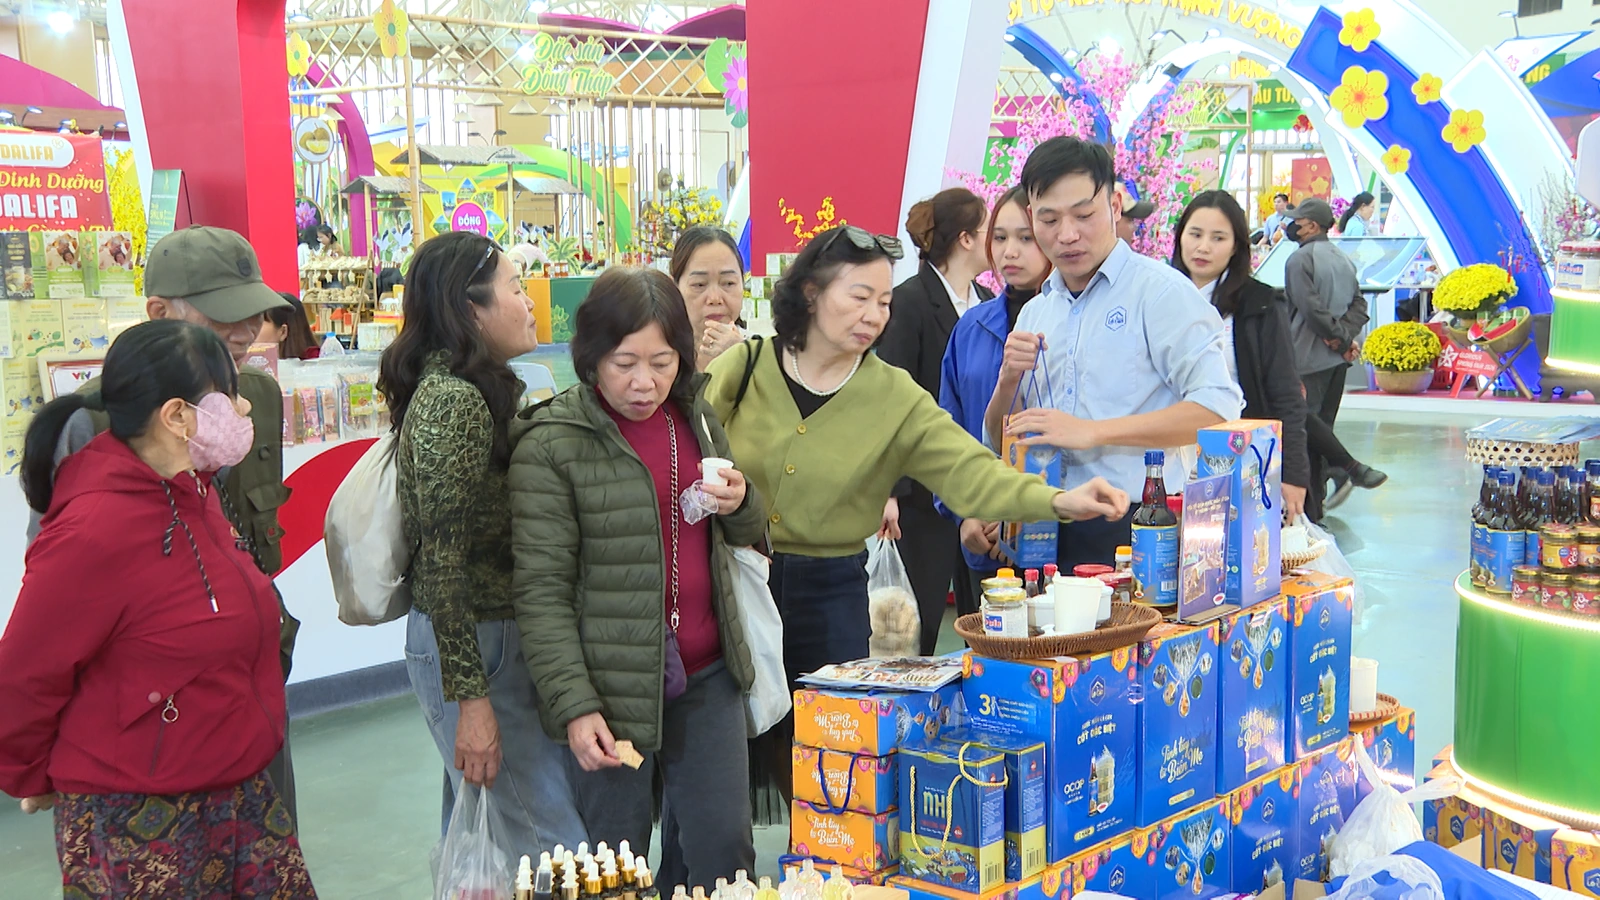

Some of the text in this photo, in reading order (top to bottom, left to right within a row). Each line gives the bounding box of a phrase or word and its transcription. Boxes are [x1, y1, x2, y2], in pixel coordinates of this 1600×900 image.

[1227, 0, 1303, 49] VƯỢNG
[573, 35, 605, 62] sản
[521, 59, 616, 99] Đồng Tháp
[47, 172, 104, 193] Dưỡng
[0, 194, 78, 218] ALIFA
[72, 371, 92, 380] VTV
[979, 694, 991, 715] 3
[1063, 778, 1085, 795] OCOP
[923, 791, 948, 819] NH
